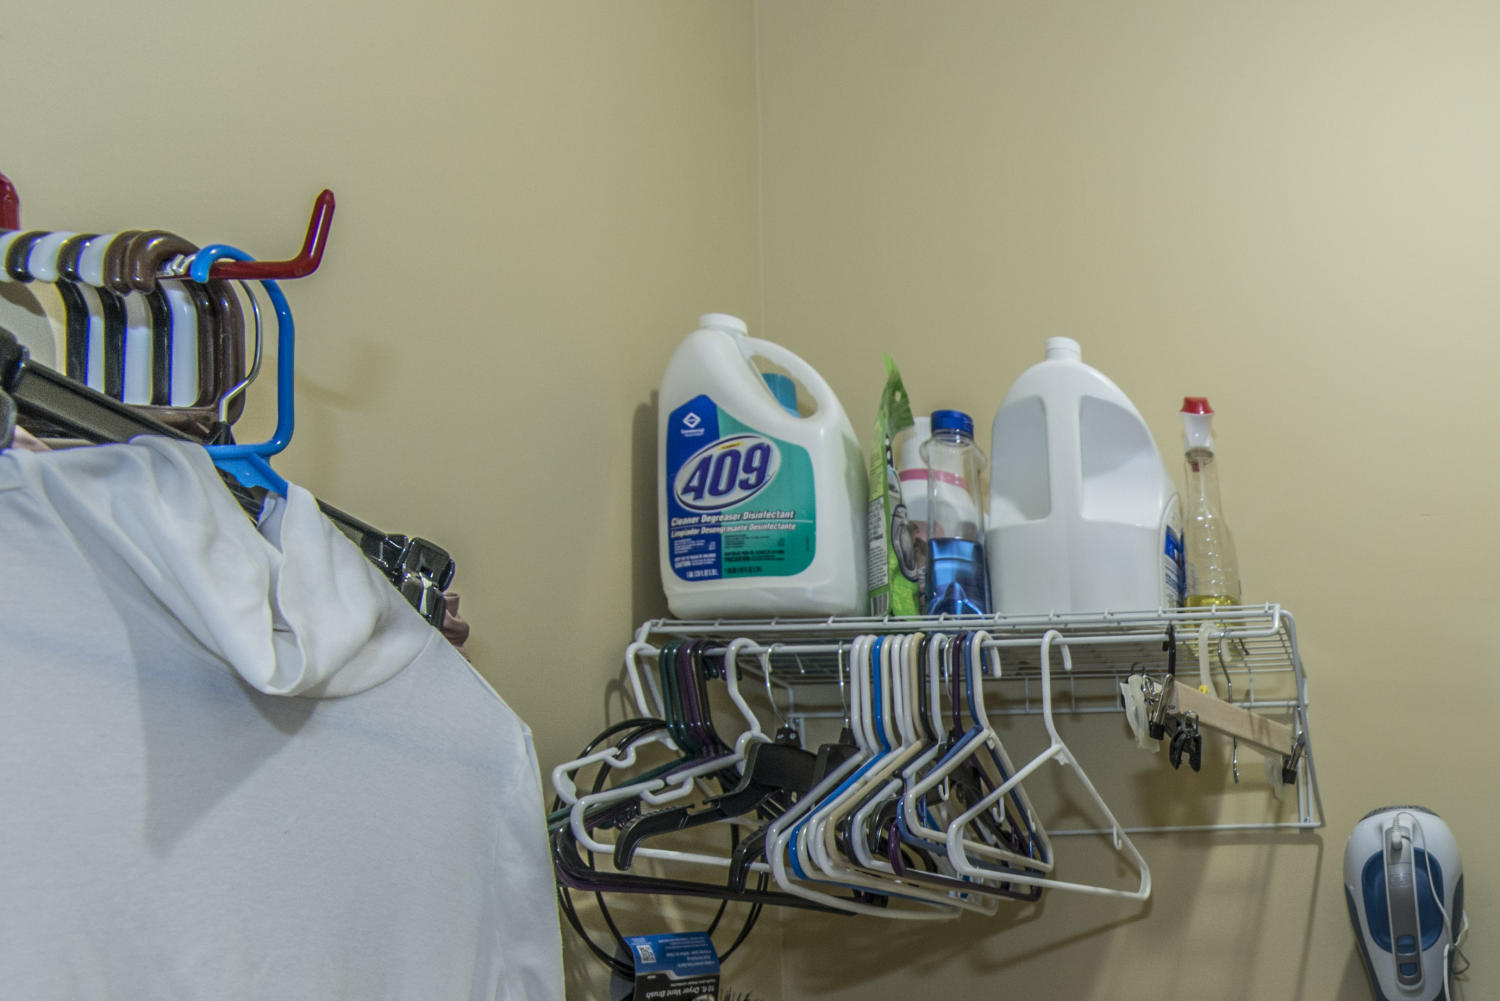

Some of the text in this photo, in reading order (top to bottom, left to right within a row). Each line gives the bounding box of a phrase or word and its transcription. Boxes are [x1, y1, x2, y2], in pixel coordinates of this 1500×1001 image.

[679, 442, 772, 501] 409
[671, 510, 796, 526] Cleaner Degreaser Disinfectant
[646, 990, 666, 999] Brush
[666, 988, 681, 996] Vent
[683, 986, 700, 994] Dryer
